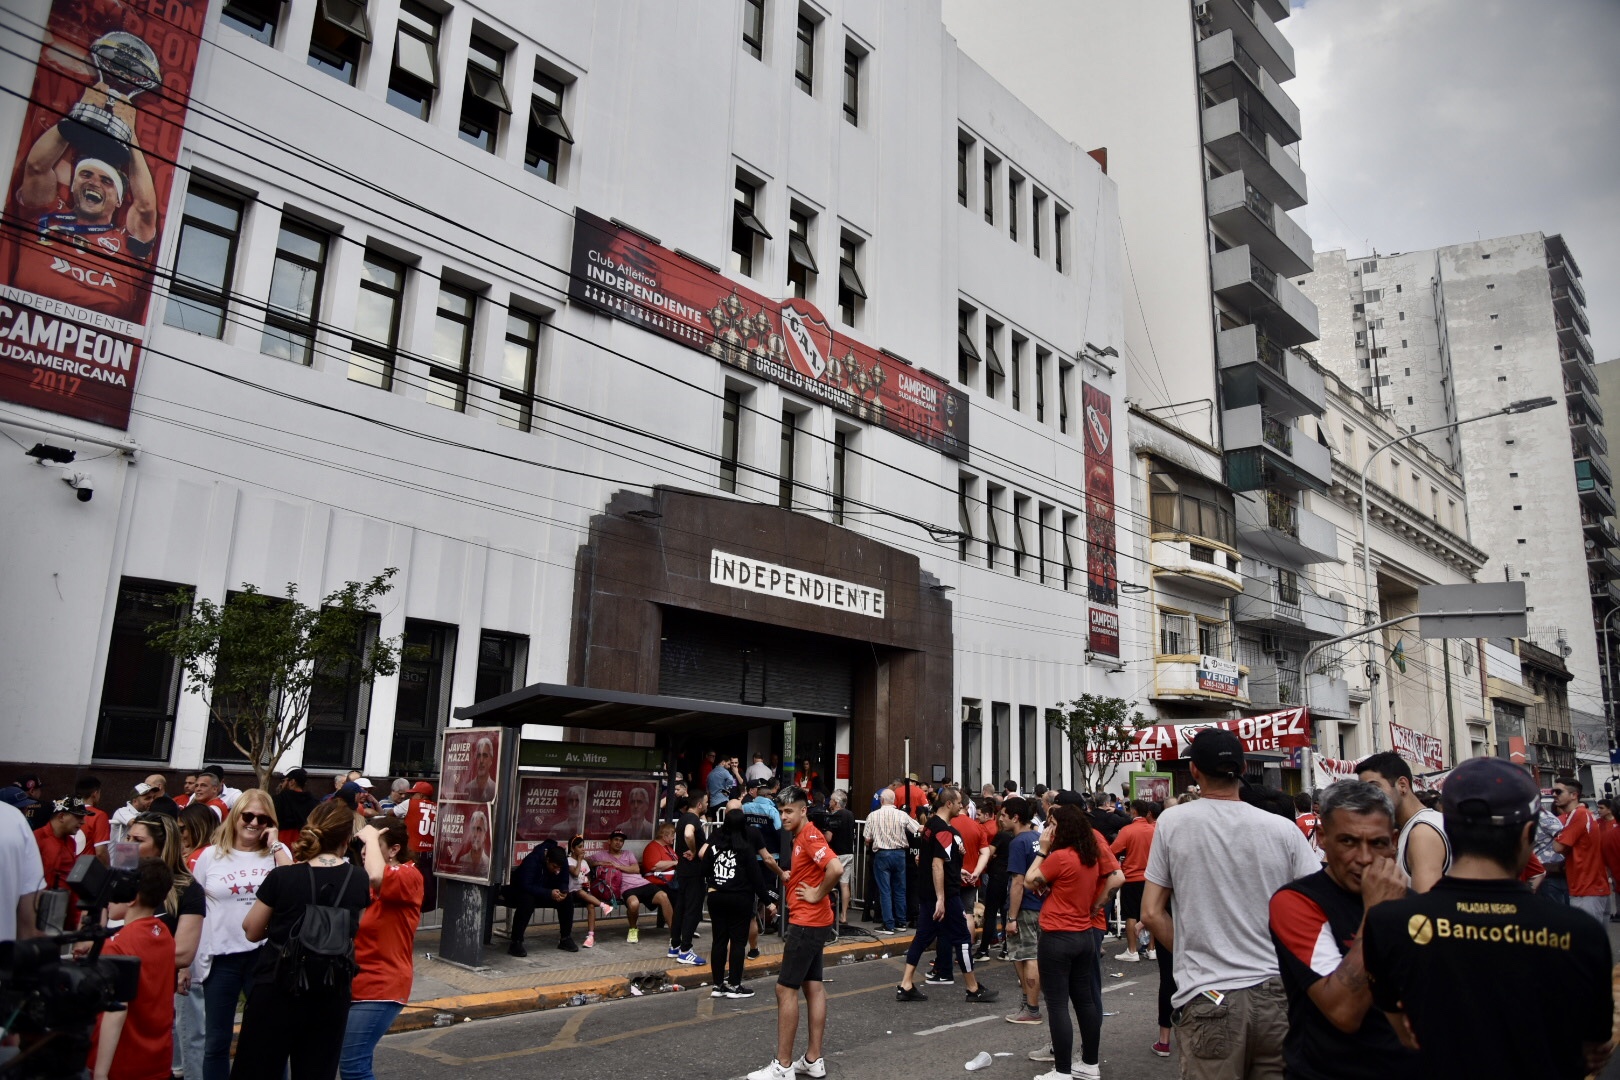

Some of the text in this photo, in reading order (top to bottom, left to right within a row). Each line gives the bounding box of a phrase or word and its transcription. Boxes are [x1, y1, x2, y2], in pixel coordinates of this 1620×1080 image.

[588, 250, 656, 287] Club Atlético
[587, 264, 702, 323] INDEPENDIENTE
[3, 288, 133, 335] INDEPENDIENTE
[0, 305, 134, 371] CAMPEON
[29, 367, 83, 398] 2017
[756, 356, 852, 408] ORGULLO NACIONAL
[898, 374, 937, 405] CAMPEON
[898, 390, 937, 412] SUDAMERICANA
[898, 401, 936, 440] 2017
[714, 555, 882, 614] INDEPENDIENTE
[1091, 610, 1118, 630] CAMPEON
[1205, 671, 1235, 685] VENDE
[1222, 708, 1304, 741] LOPEZ
[448, 742, 471, 752] JAVIER
[1086, 725, 1173, 752] MAZZA
[1247, 738, 1280, 752] VICE
[447, 752, 470, 763] MAZZA
[565, 752, 580, 762] Av.
[583, 753, 608, 763] Mitre
[1091, 750, 1162, 763] PRESIDENTE
[527, 788, 559, 797] JAVIER
[593, 790, 623, 798] JAVIER
[526, 797, 559, 807] MAZZA
[592, 798, 621, 807] MAZZA
[442, 814, 465, 824] JAVIER
[441, 824, 464, 834] MAZZA
[219, 869, 247, 884] 70'S
[1456, 902, 1517, 915] PALADAR NEGRO
[1436, 918, 1571, 950] BancoCiudad
